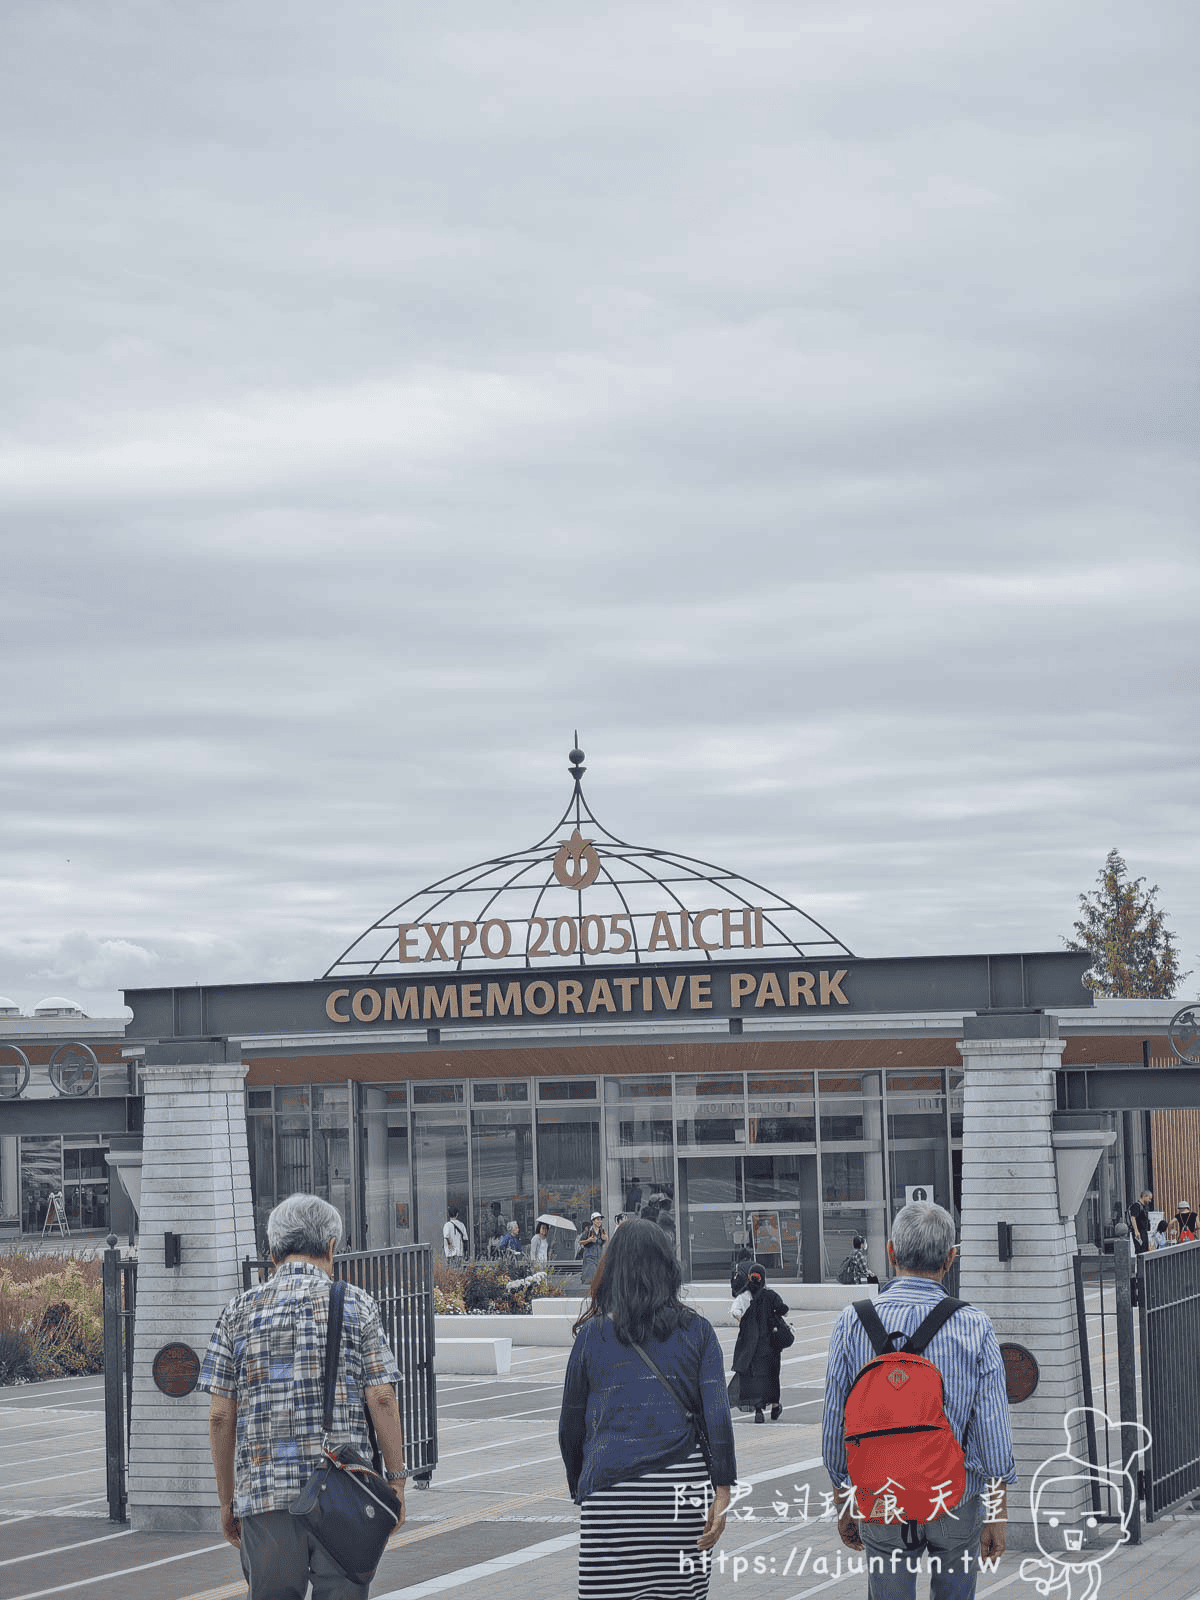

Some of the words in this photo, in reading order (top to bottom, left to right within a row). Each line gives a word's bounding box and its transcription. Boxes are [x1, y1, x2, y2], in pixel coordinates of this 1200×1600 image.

[399, 918, 512, 964] EXPO
[527, 913, 633, 958] 2005
[647, 906, 764, 953] AICHI
[325, 974, 713, 1023] COMMEMORATIVE
[729, 969, 850, 1008] PARK
